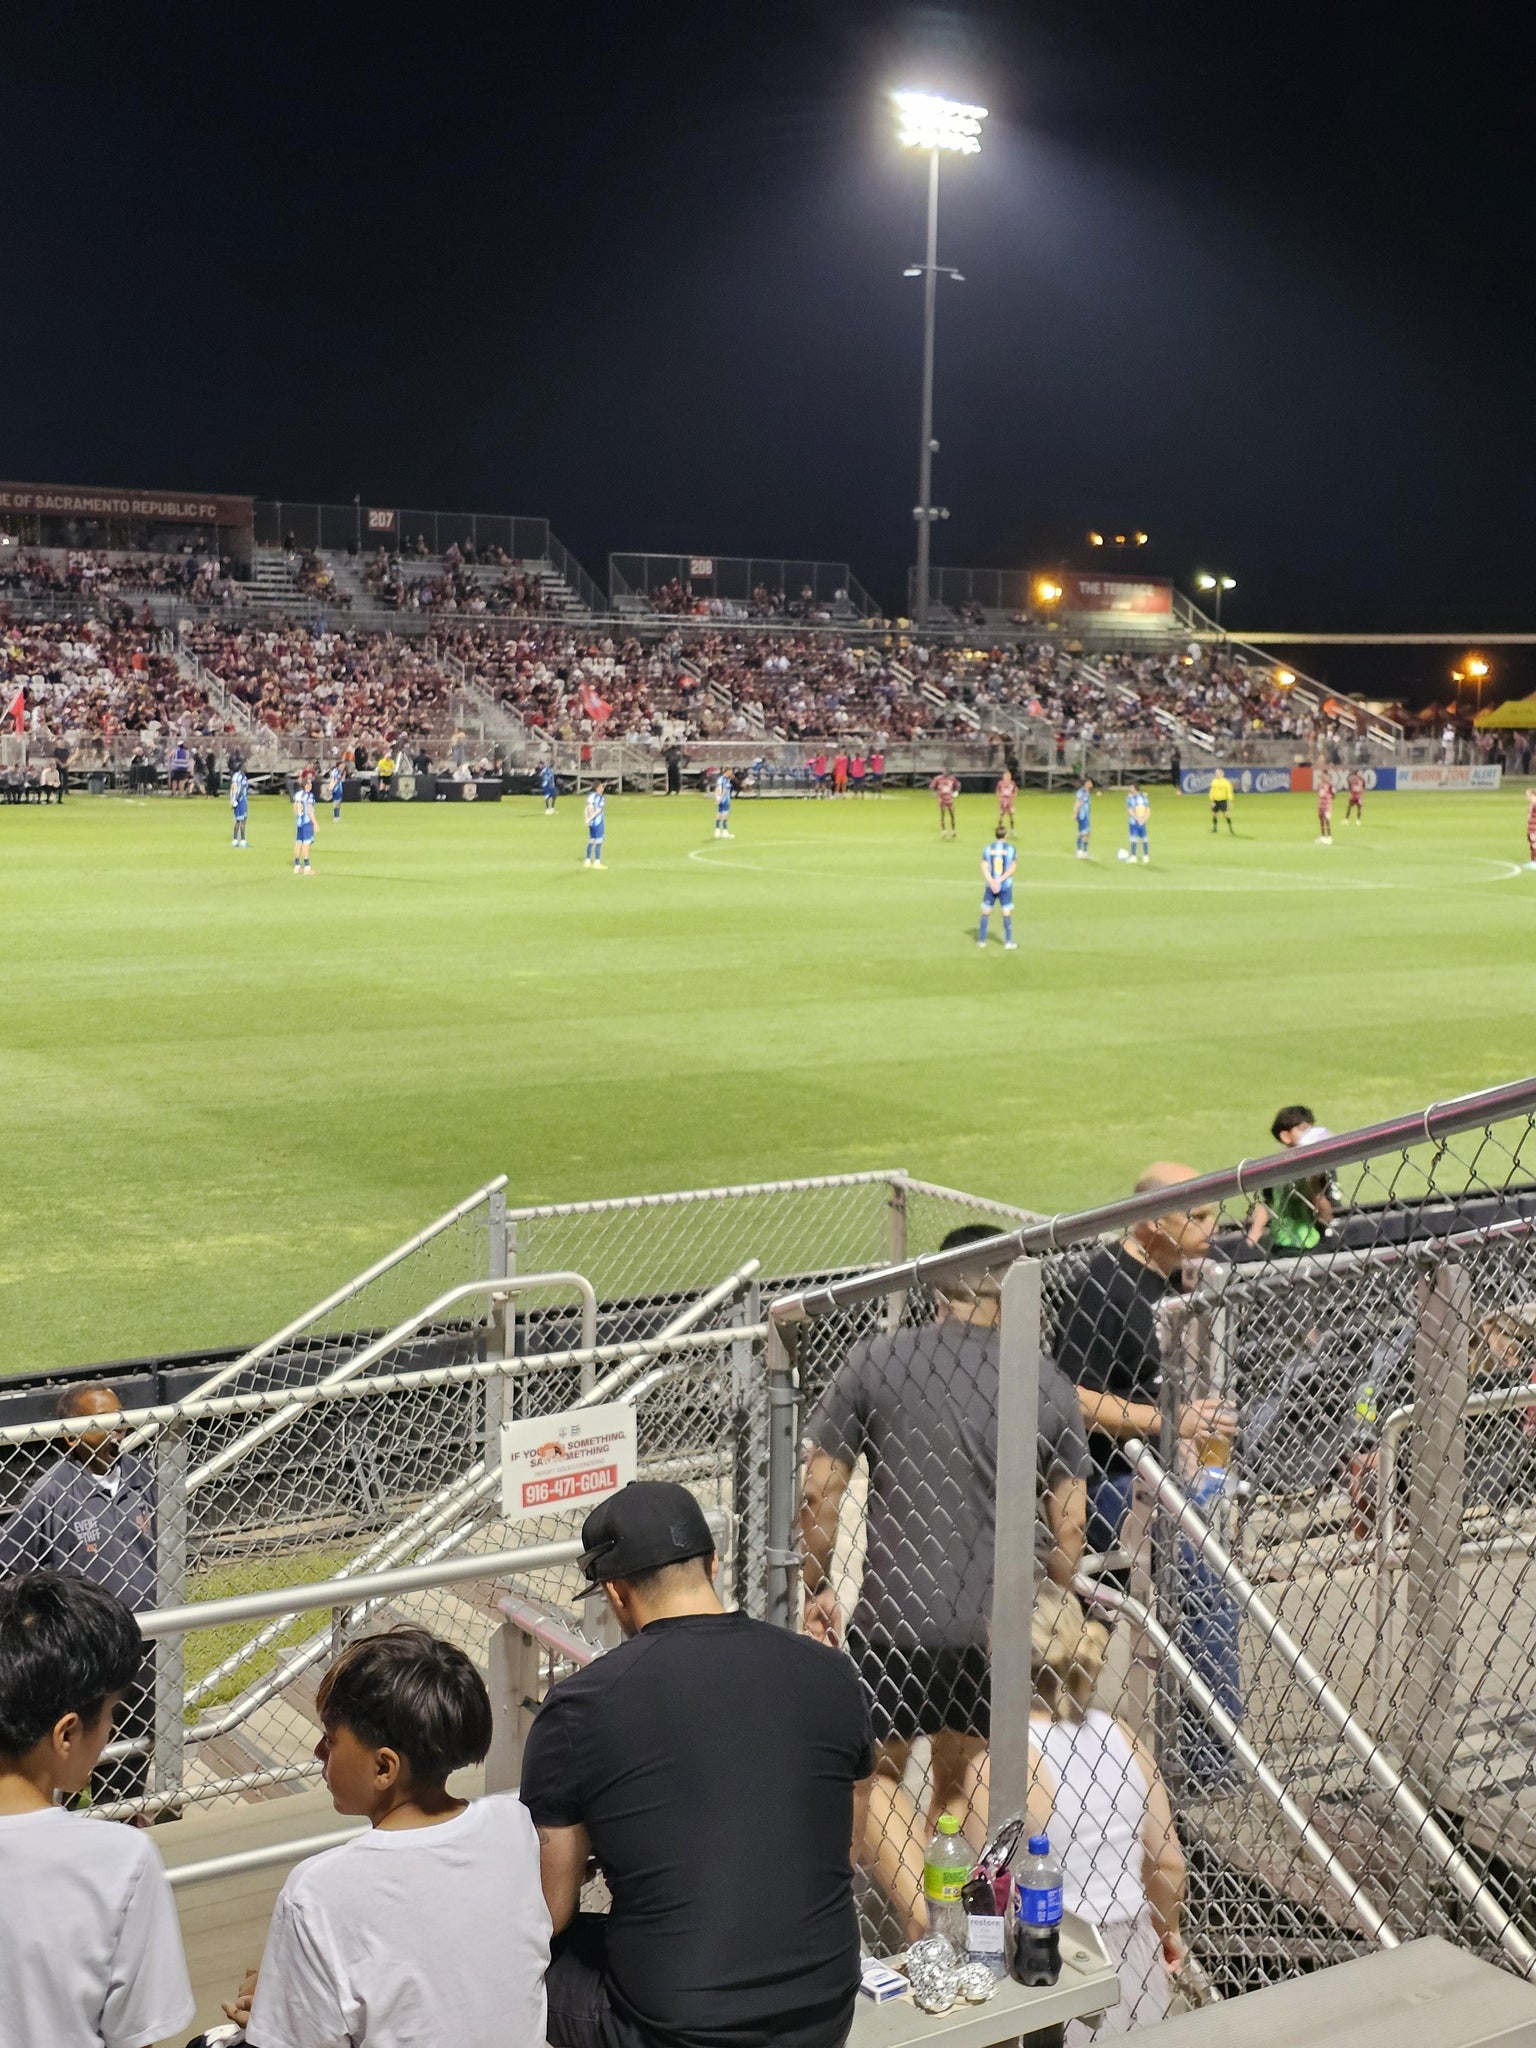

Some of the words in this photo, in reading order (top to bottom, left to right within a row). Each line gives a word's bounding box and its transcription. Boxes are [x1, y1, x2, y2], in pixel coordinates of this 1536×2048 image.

[14, 494, 33, 508] OF
[35, 495, 130, 514] SACRAMENTO
[132, 500, 197, 517] REPUBLIC
[199, 504, 217, 518] FC
[369, 510, 394, 528] 207
[1079, 581, 1101, 595] THE
[511, 1452, 521, 1461] IF
[526, 1469, 614, 1503] 916-471-GOAL
[970, 1919, 1001, 1927] restore
